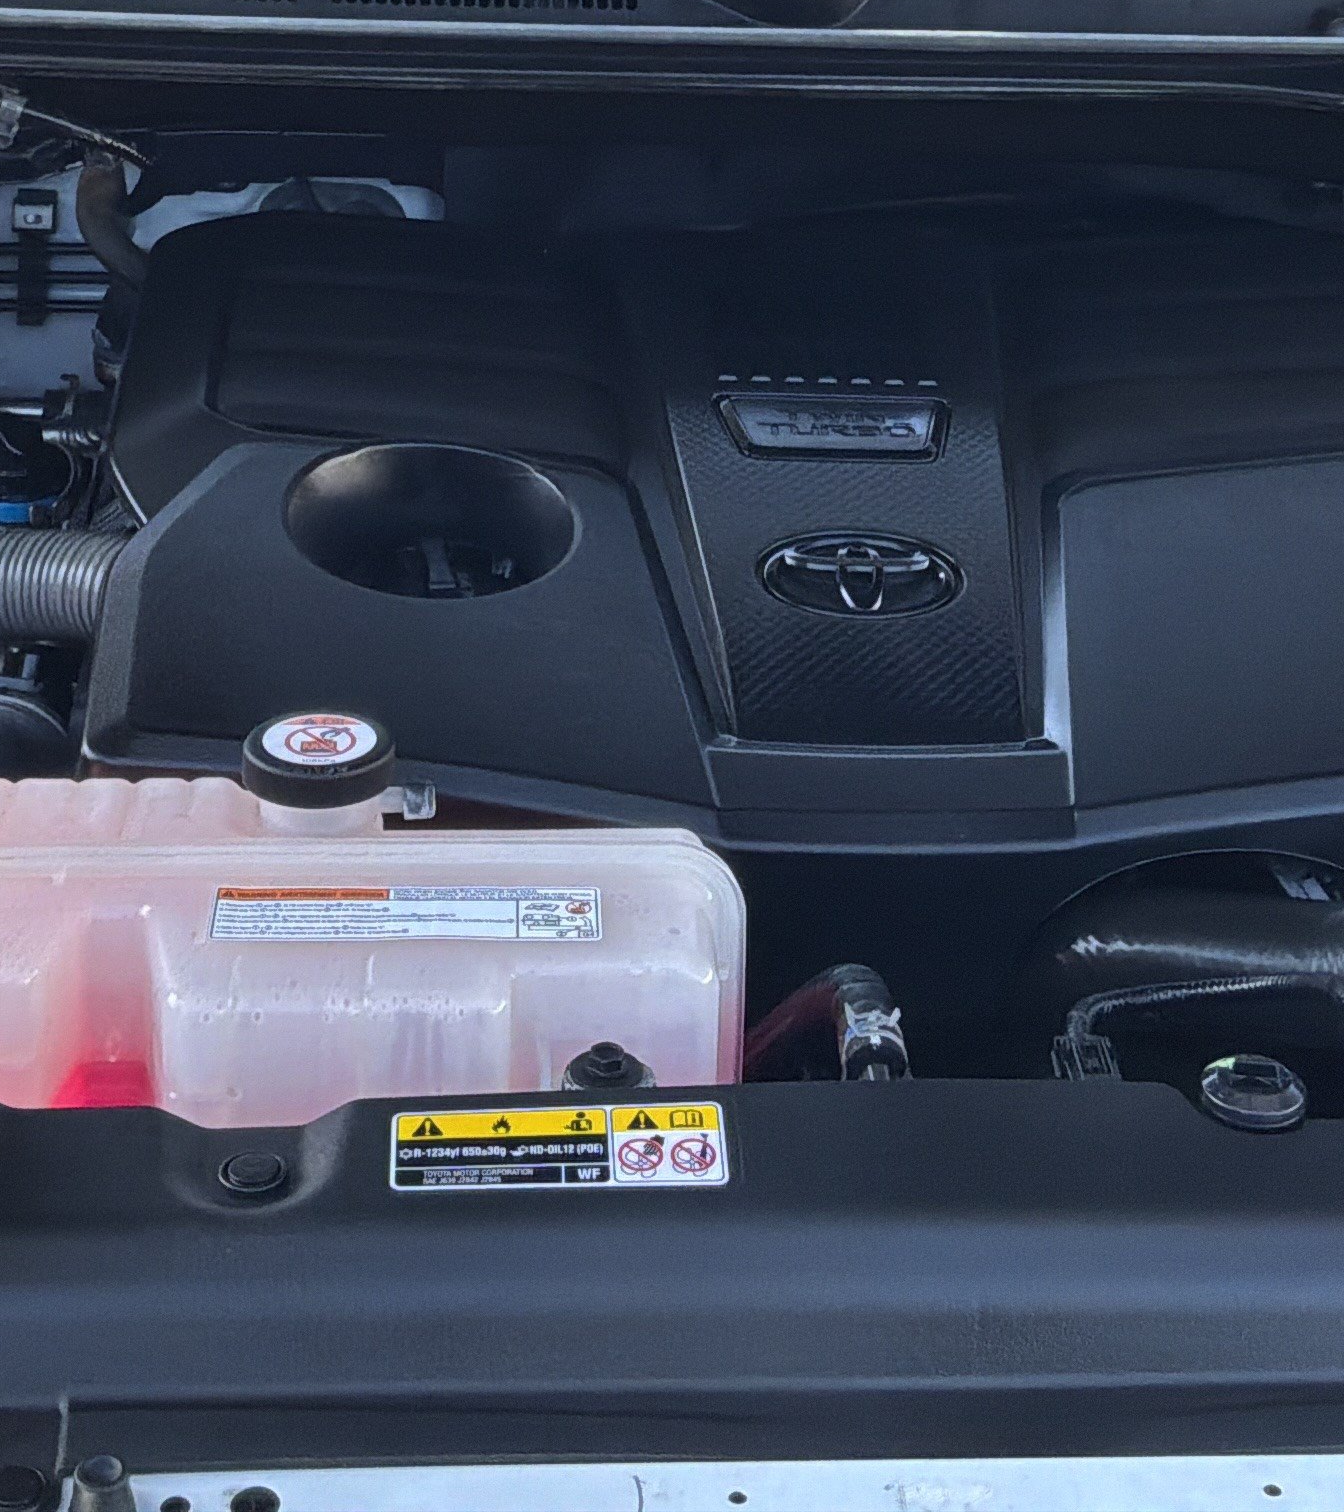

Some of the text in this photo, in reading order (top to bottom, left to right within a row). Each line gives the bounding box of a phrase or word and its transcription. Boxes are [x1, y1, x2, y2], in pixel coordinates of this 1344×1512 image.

[757, 422, 916, 438] TURBO
[576, 1143, 604, 1155] (POE)
[452, 1169, 480, 1177] MOTOR
[481, 1168, 533, 1176] CORPORATION
[577, 1168, 601, 1180] WF
